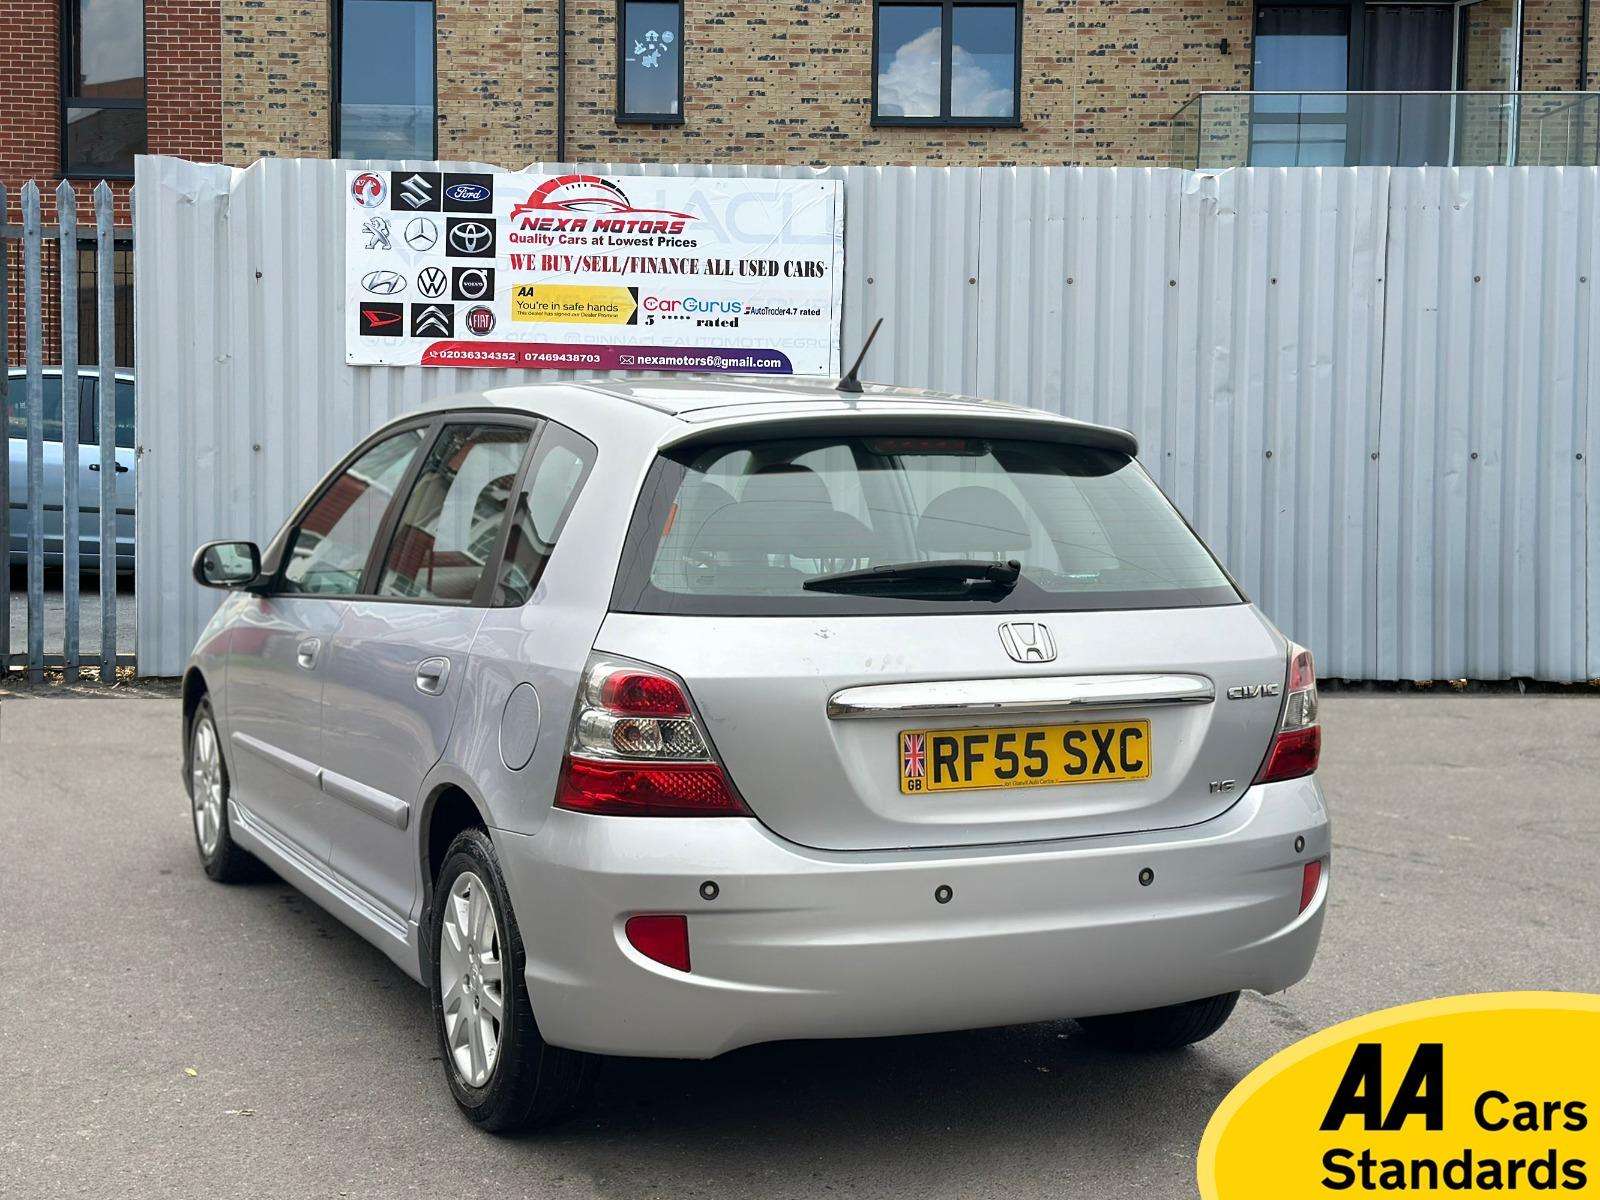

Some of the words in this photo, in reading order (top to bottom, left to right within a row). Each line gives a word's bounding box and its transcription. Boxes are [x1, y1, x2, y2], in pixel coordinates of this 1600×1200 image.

[453, 187, 482, 200] Ford
[520, 217, 588, 232] NEXA
[593, 219, 686, 234] MOTORS
[509, 232, 555, 246] Quality
[559, 234, 588, 246] Cars
[591, 235, 604, 246] at
[608, 235, 654, 247] Lowest
[657, 236, 698, 248] Prices
[509, 253, 536, 271] WE
[541, 254, 699, 276] BUY/SELL/FINANCE
[703, 258, 734, 276] ALL
[739, 259, 780, 277] USED
[784, 260, 825, 278] CARS
[517, 286, 534, 297] AA
[516, 300, 549, 310] You're
[551, 301, 560, 310] in
[562, 302, 585, 311] safe
[587, 302, 619, 312] hands
[643, 296, 742, 313] CarGurus
[473, 314, 489, 324] FIAT
[799, 308, 821, 316] rated
[645, 314, 655, 326] 5
[696, 316, 739, 328] rated
[439, 350, 516, 361] 02036334352
[525, 353, 601, 363] 07469438703
[637, 354, 781, 369] nexamotors6@gmail.com
[1227, 683, 1280, 700] CIVIC
[932, 732, 1049, 784] RF55
[1063, 727, 1144, 776] SXC
[907, 779, 922, 791] GB
